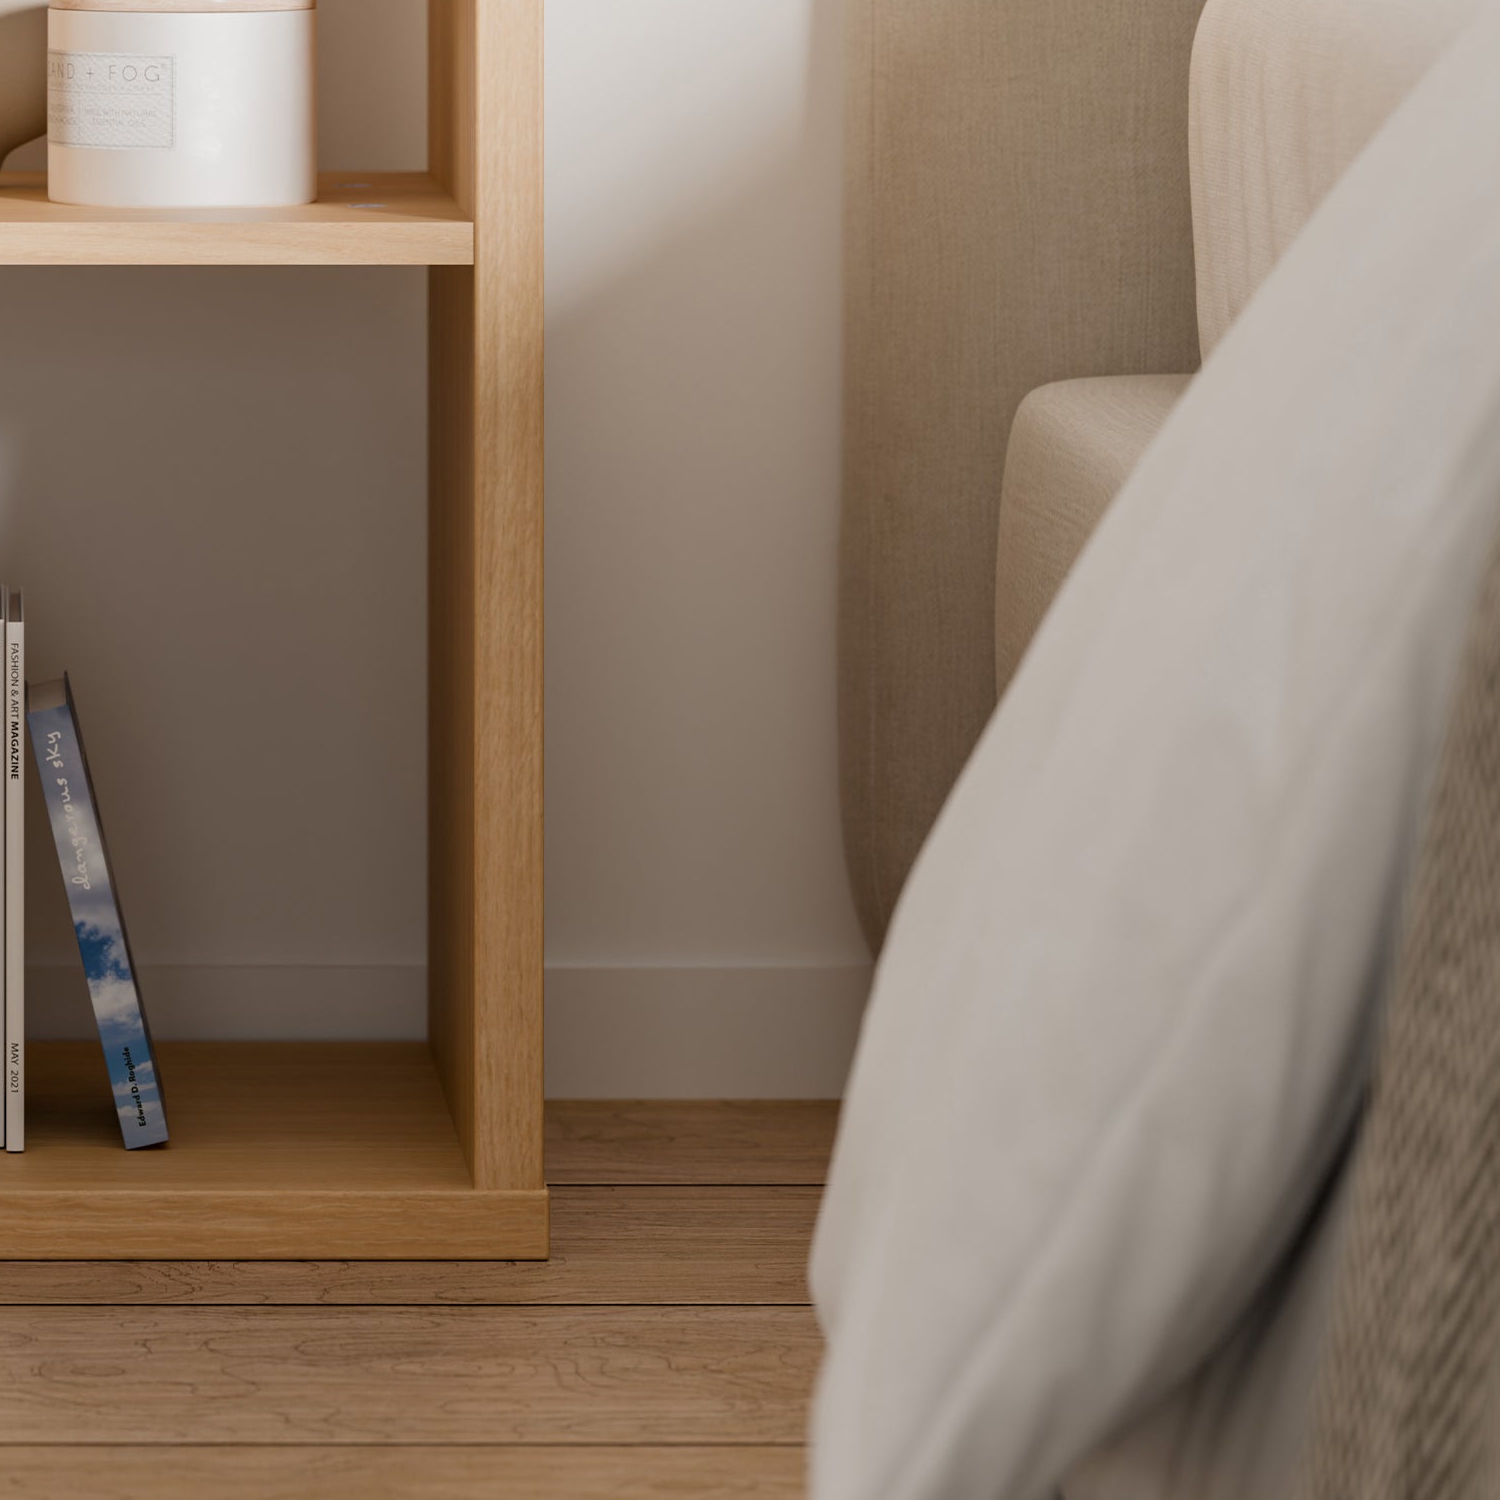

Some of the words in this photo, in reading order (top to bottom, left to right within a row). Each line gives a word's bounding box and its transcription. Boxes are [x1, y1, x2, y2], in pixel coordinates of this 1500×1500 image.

[108, 64, 160, 82] FOG
[11, 642, 19, 687] FASHION
[11, 689, 19, 698] &
[11, 699, 19, 719] ART
[11, 721, 19, 780] MAGAZINE
[46, 731, 64, 768] sky
[57, 778, 91, 890] dangerous
[11, 1042, 19, 1067] MAY
[11, 1070, 19, 1093] 2021
[131, 1083, 139, 1093] D.
[132, 1094, 147, 1127] Edward
